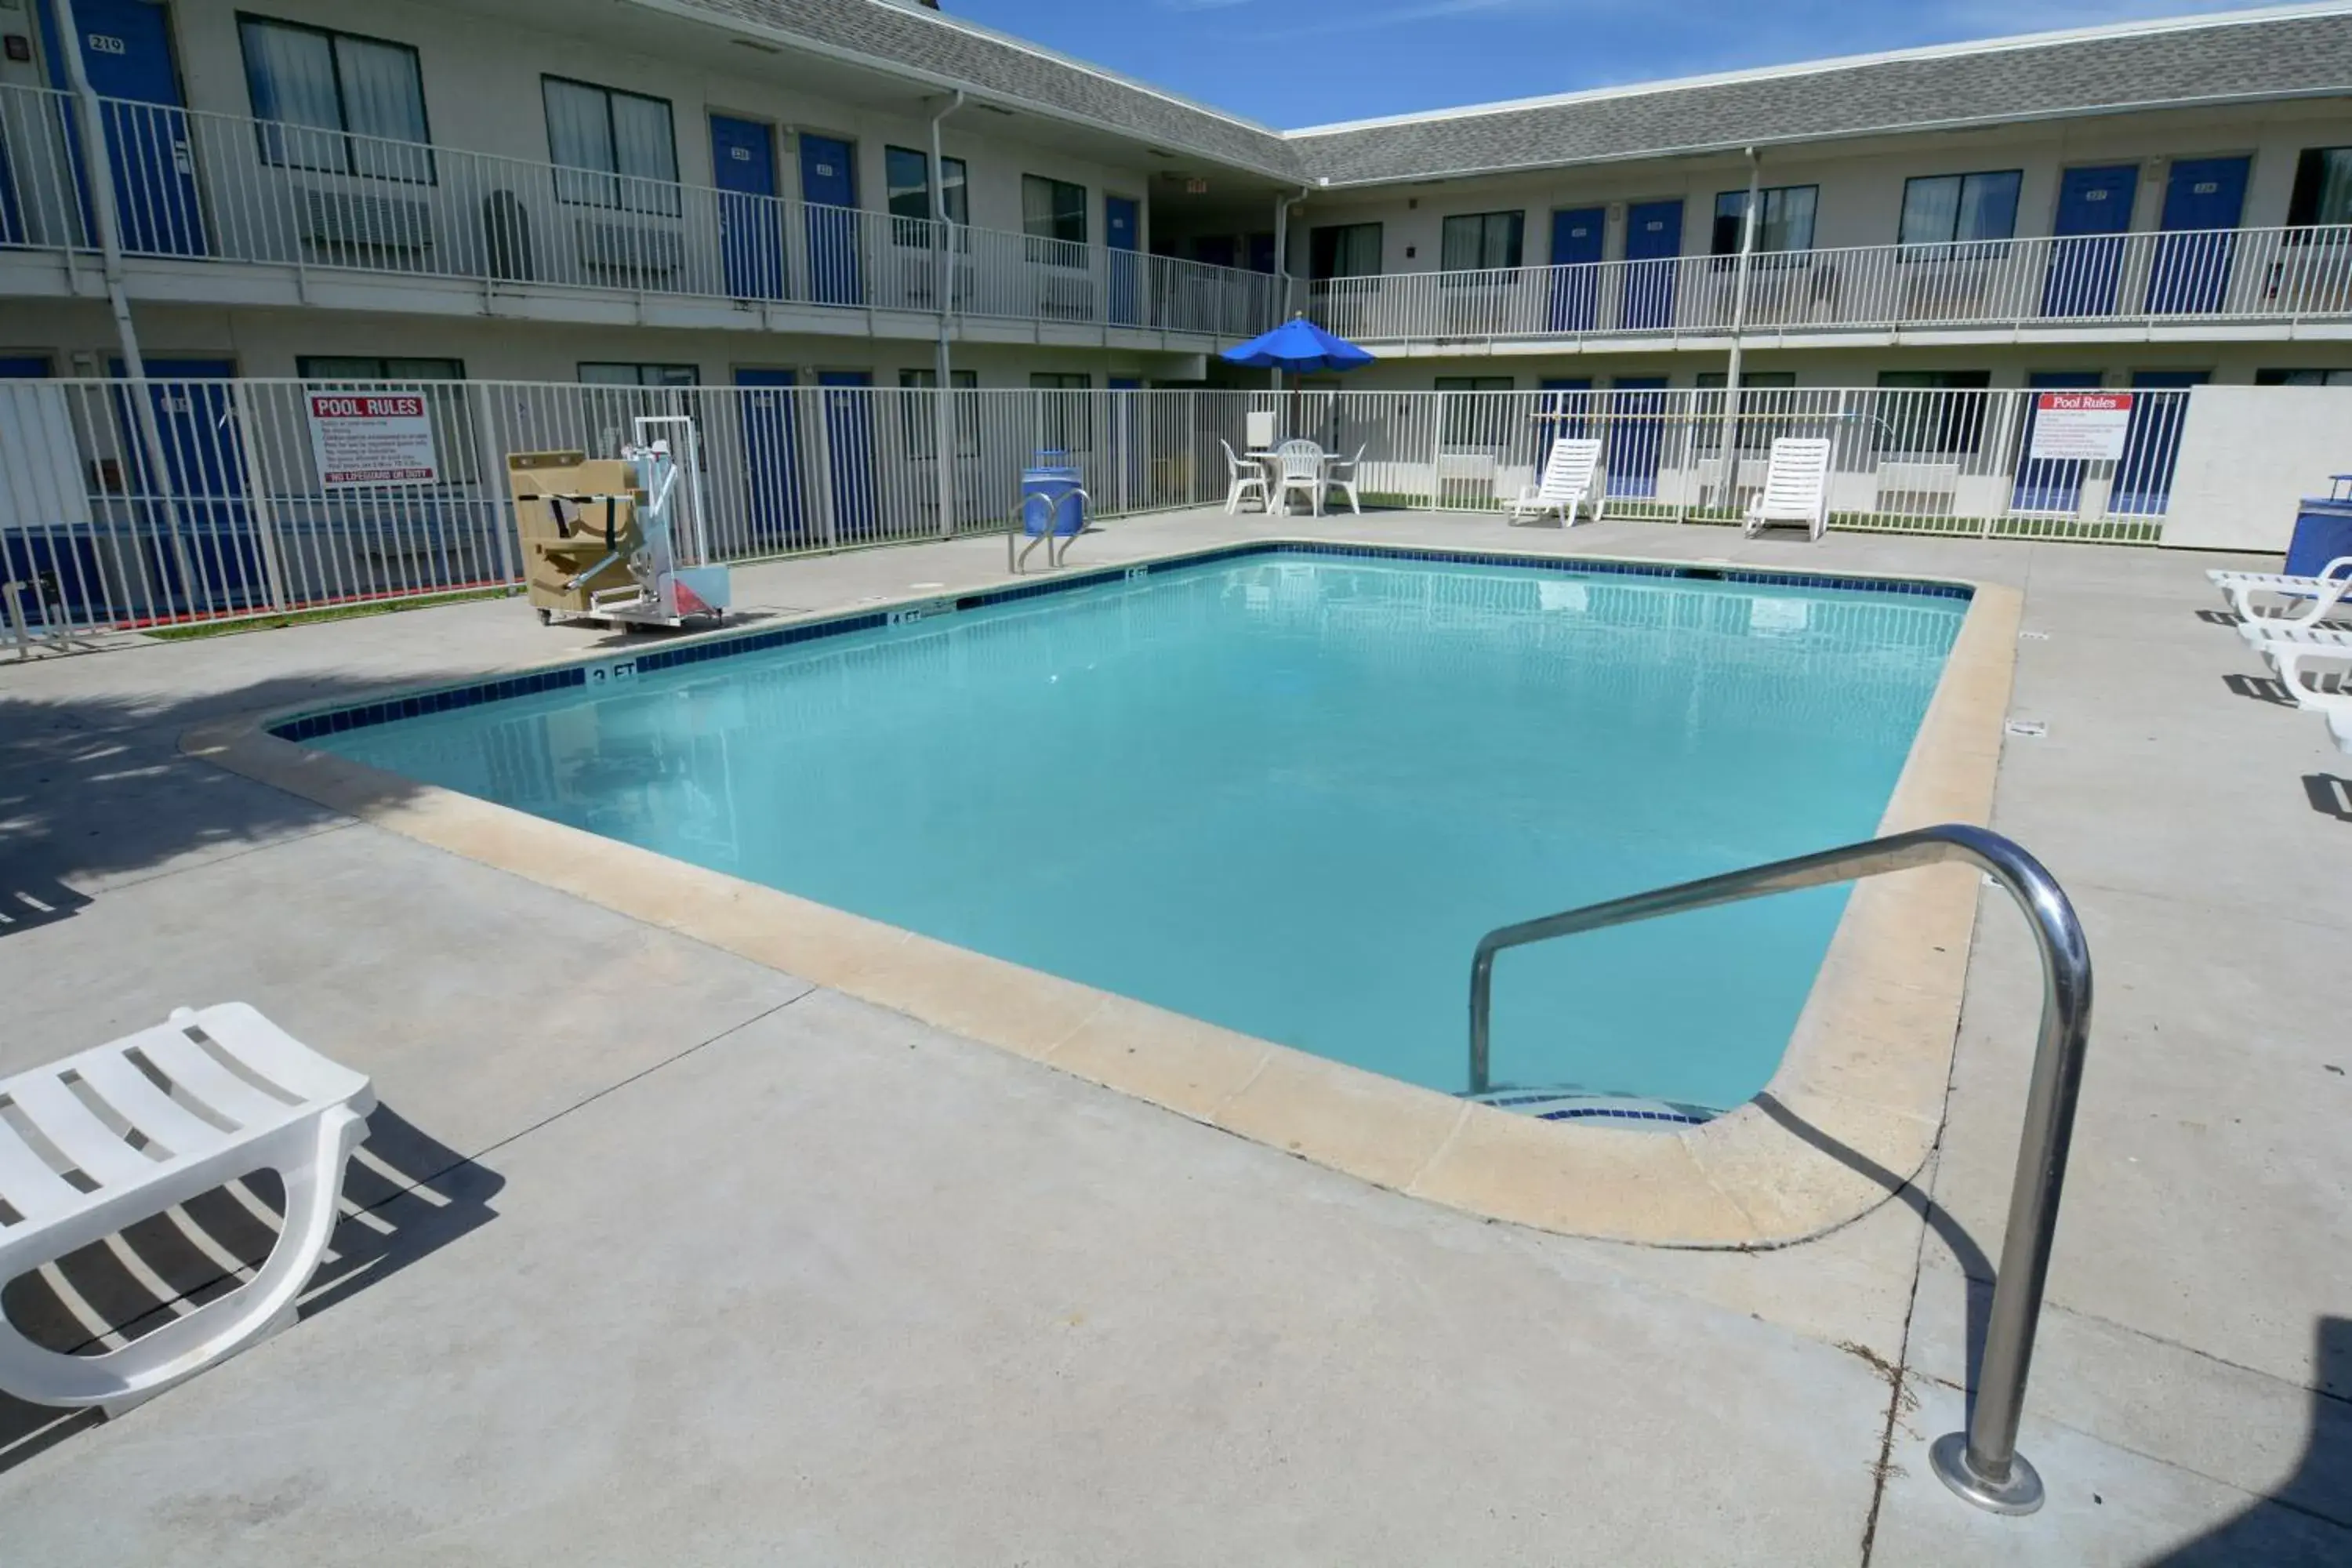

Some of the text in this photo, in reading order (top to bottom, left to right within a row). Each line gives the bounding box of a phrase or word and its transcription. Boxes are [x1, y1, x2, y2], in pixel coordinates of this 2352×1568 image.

[92, 37, 121, 50] 219
[318, 399, 418, 415] POOL RULES
[2053, 396, 2116, 408] Pool Rules
[614, 663, 634, 677] FT
